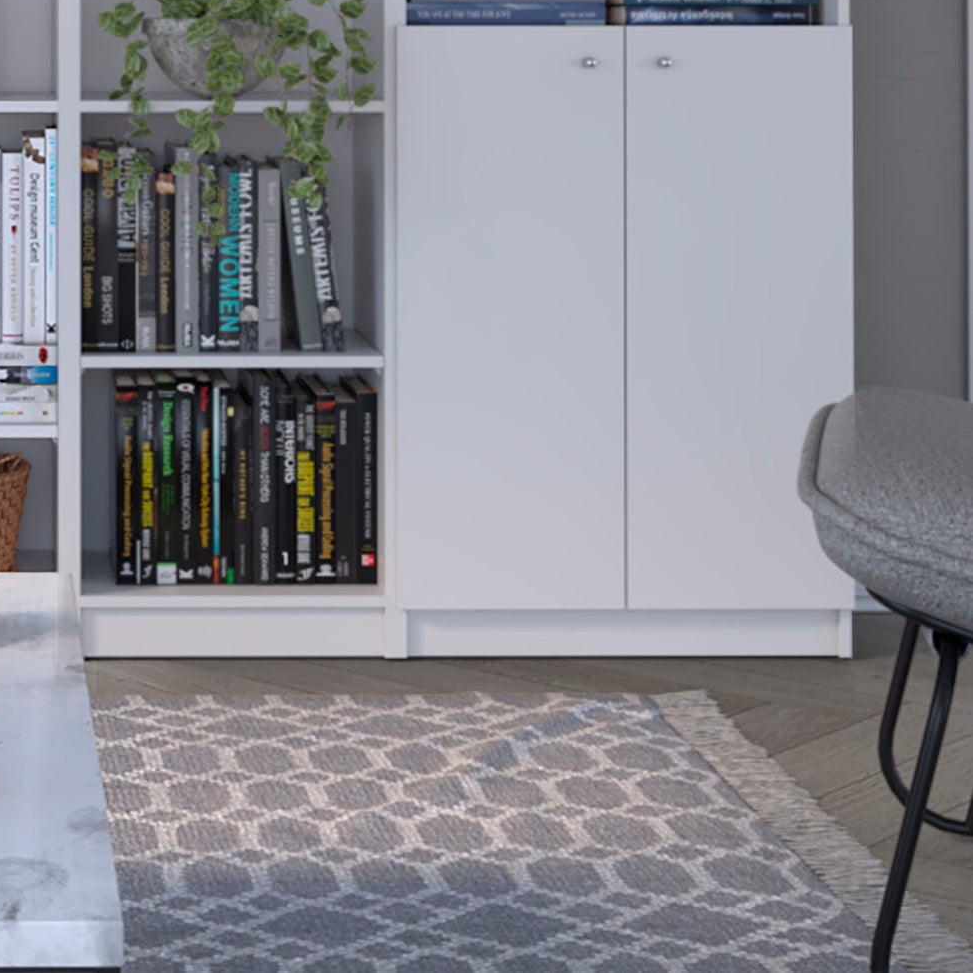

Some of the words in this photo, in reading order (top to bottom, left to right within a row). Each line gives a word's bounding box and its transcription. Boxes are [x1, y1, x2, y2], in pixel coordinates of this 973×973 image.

[10, 165, 20, 221] TULIPS
[26, 173, 40, 203] Design
[83, 188, 95, 221] COOL
[228, 174, 240, 232] MODERN
[26, 204, 40, 240] museum
[159, 208, 171, 238] COOL
[83, 226, 95, 261] GUIDE
[159, 241, 171, 273] GUIDE
[219, 234, 240, 332] WOMEN
[309, 230, 333, 302] ARTEMIS
[83, 266, 95, 308] London
[101, 276, 113, 293] BIG
[101, 294, 113, 325] SHOTS
[162, 401, 173, 432] Design
[162, 434, 173, 476] Research
[285, 420, 296, 484] INTERIORS
